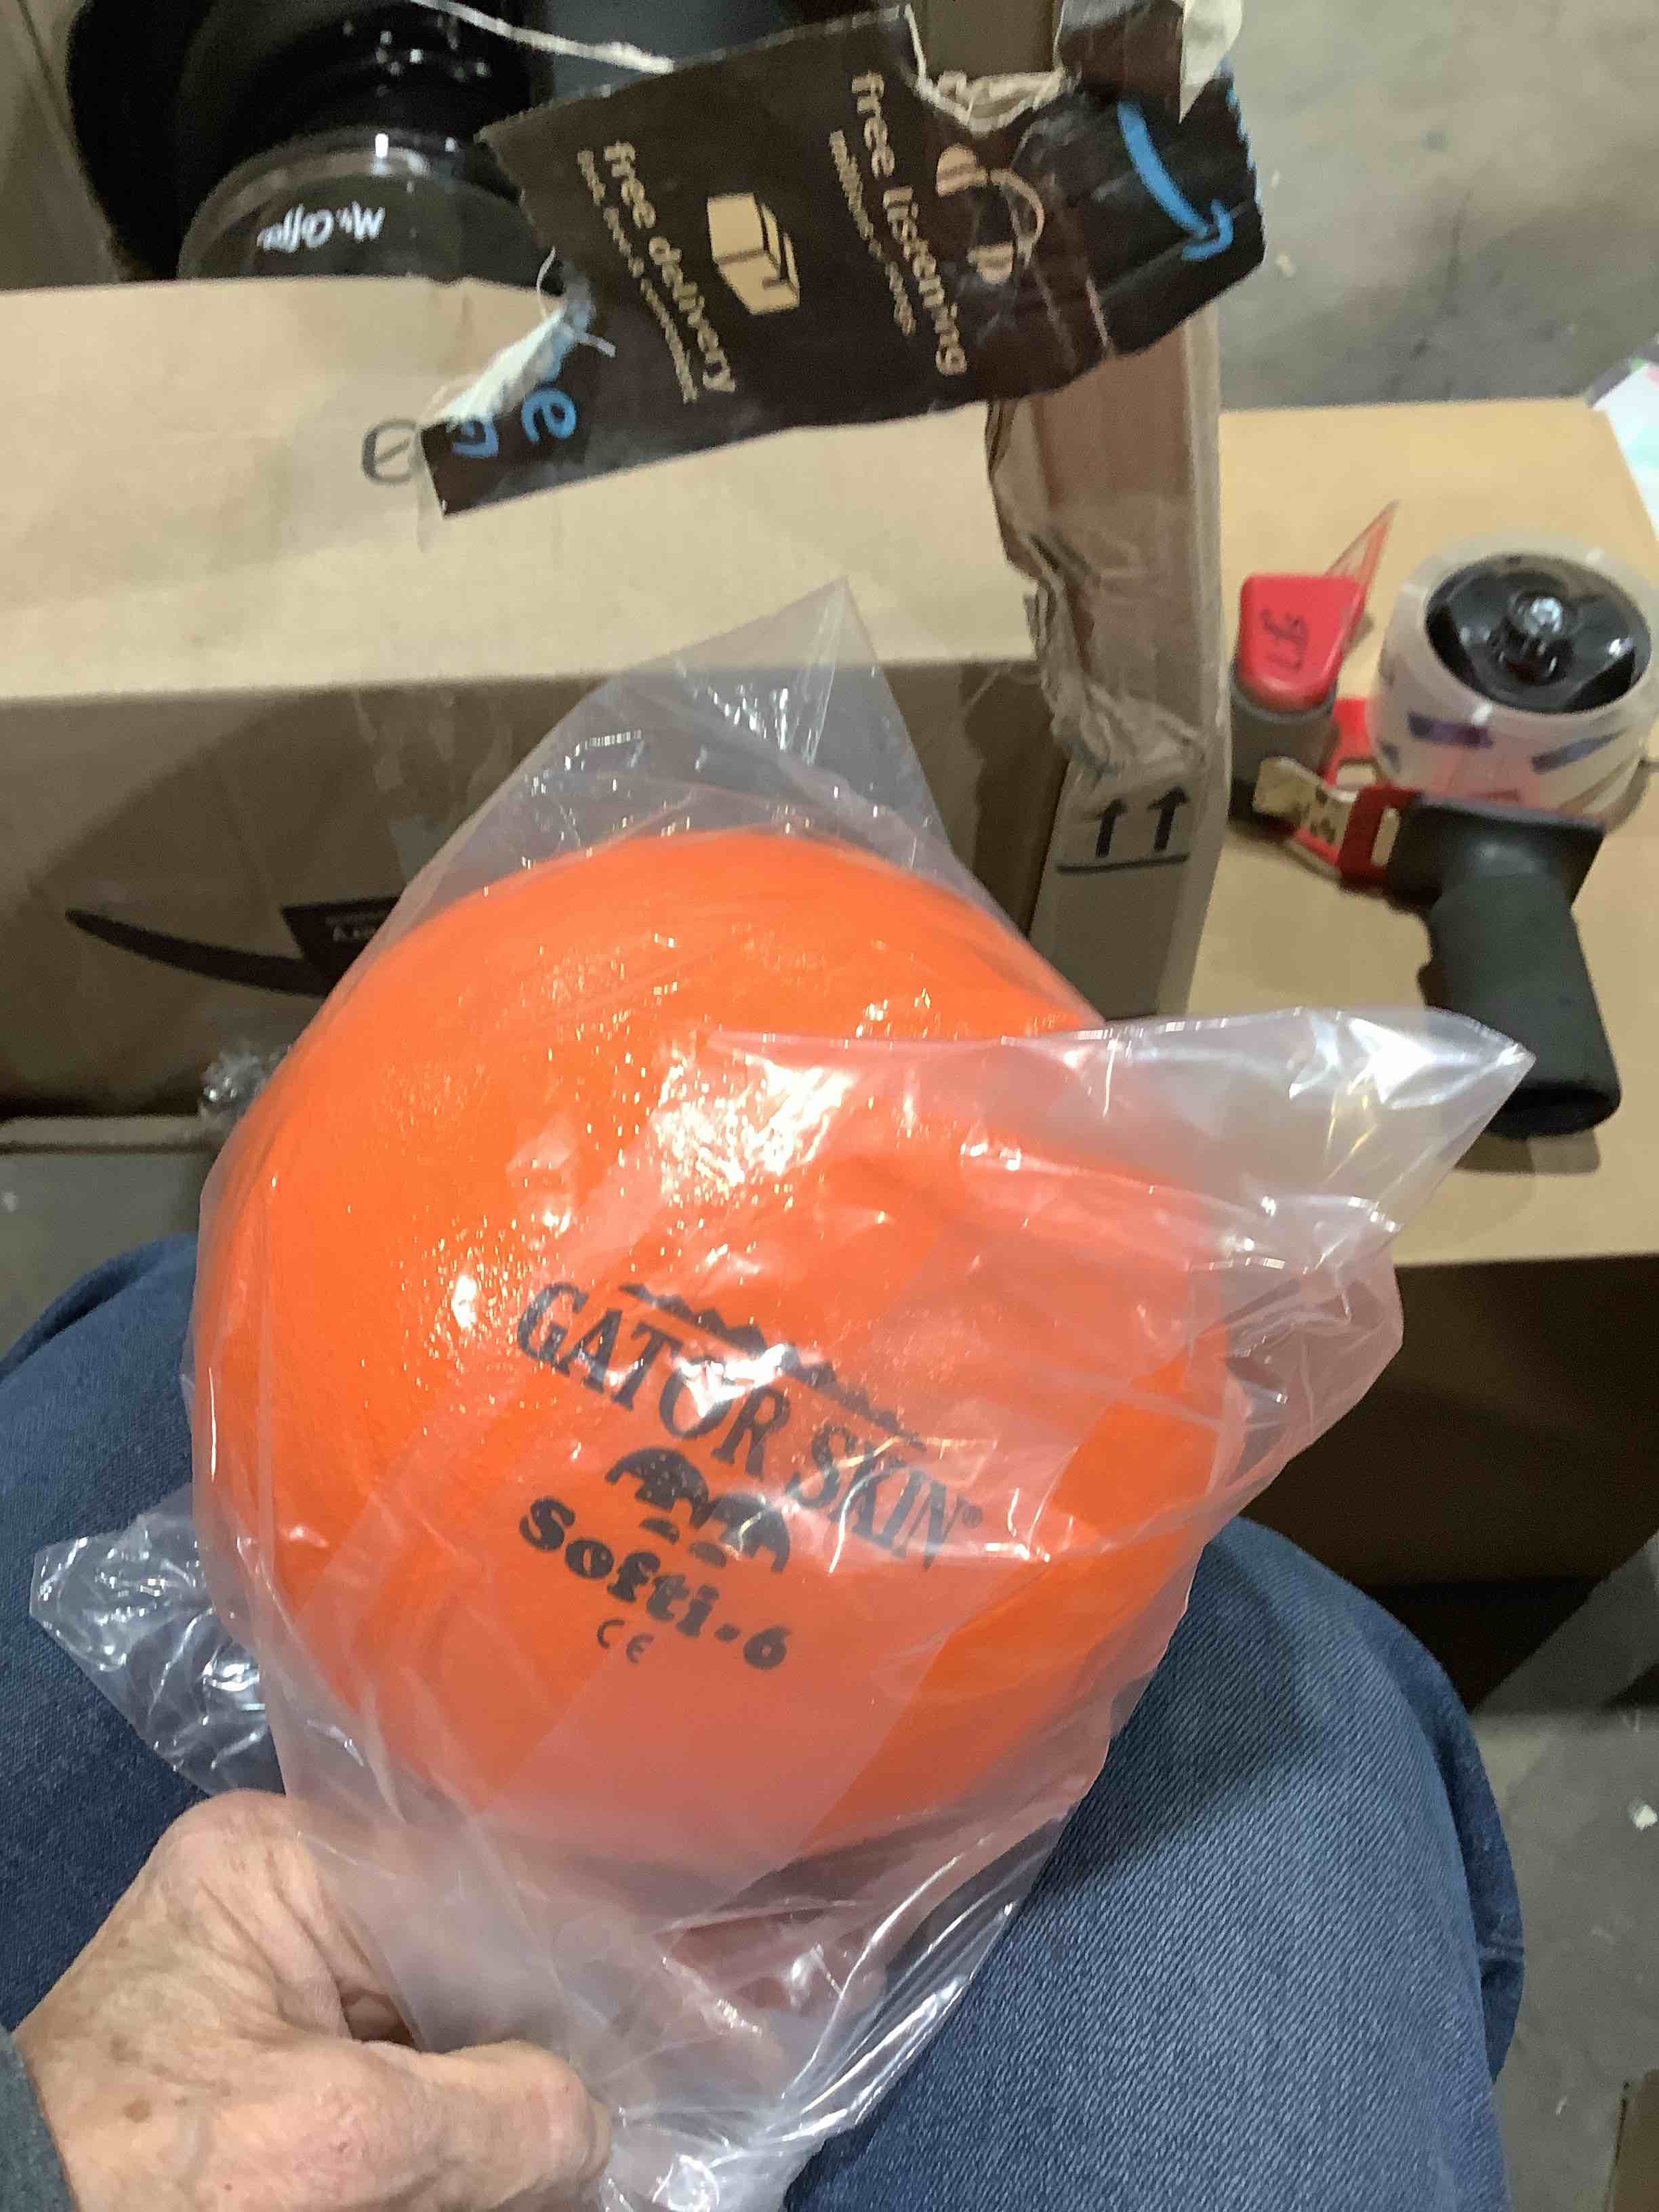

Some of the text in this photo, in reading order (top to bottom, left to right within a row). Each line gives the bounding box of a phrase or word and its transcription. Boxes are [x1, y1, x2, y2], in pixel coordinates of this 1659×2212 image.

[604, 142, 655, 228] free
[851, 73, 895, 177] free
[517, 1283, 792, 1479] GATOR
[520, 1497, 791, 1668] Softi-6
